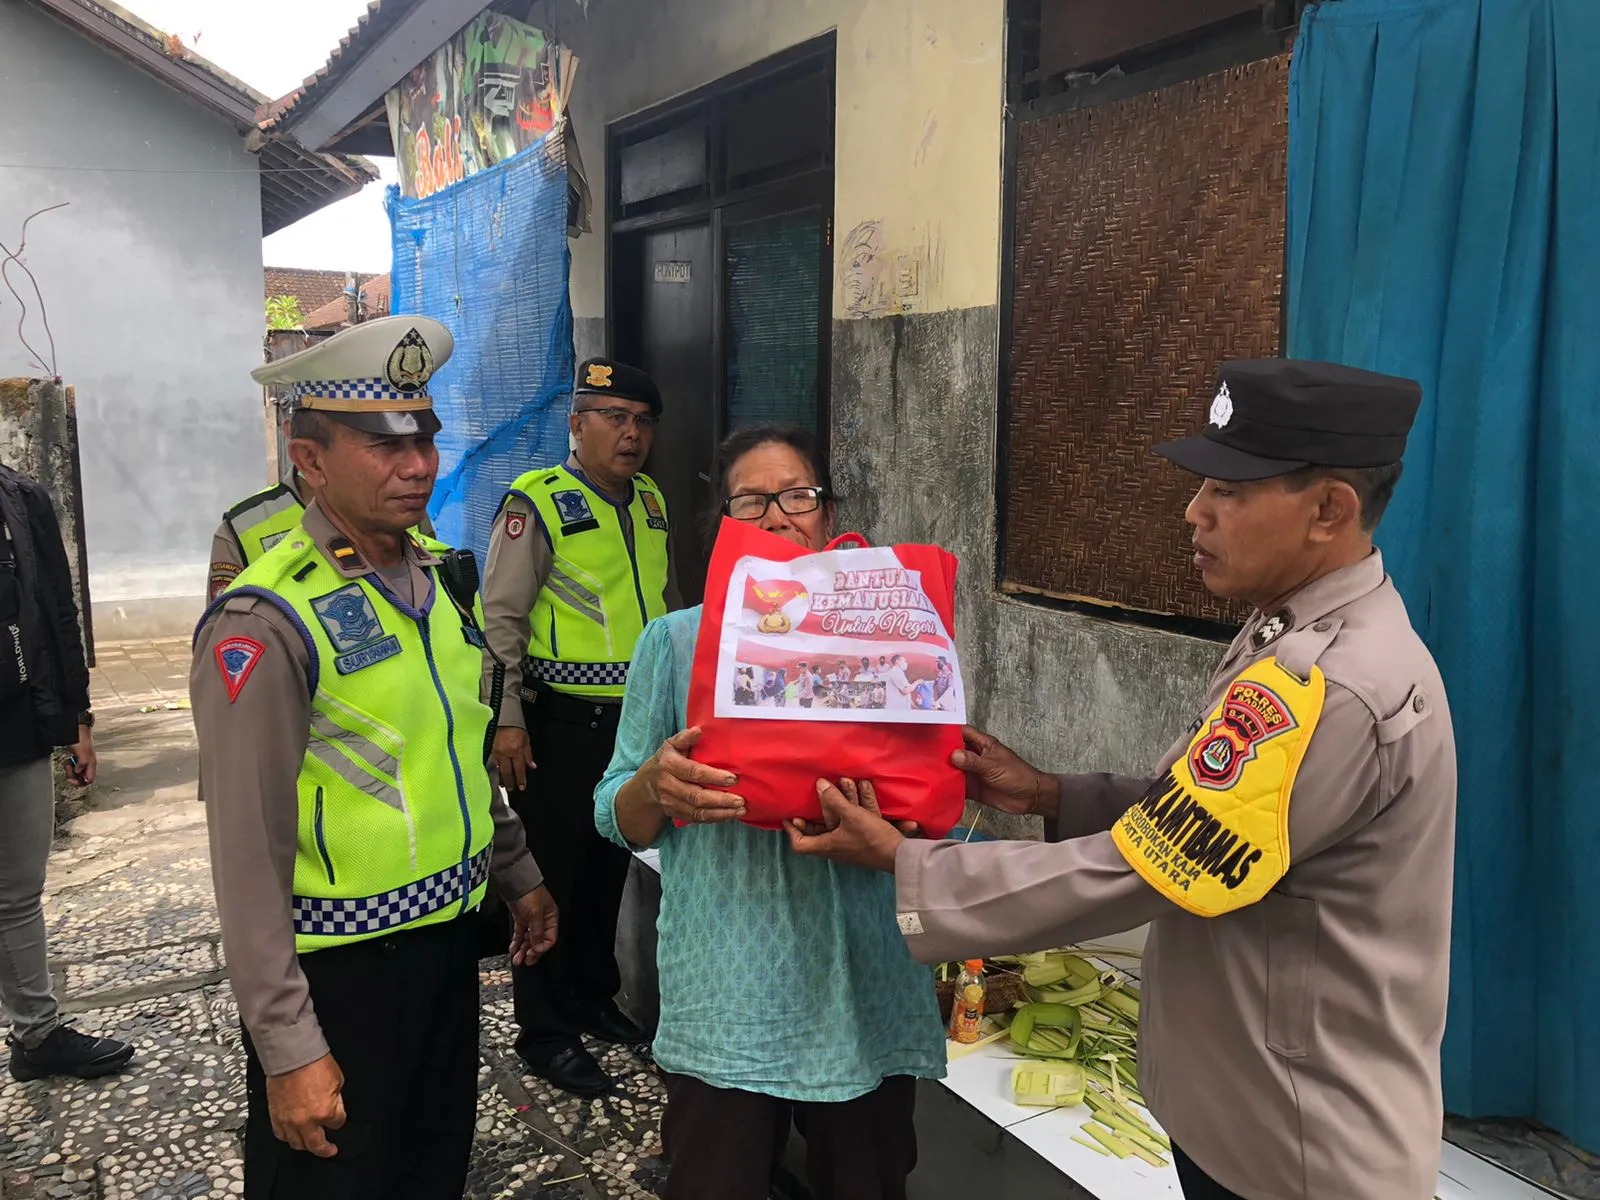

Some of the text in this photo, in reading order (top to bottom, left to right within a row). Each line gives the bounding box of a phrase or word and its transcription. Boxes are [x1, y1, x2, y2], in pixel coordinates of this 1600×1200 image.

[415, 114, 463, 200] Bali
[821, 610, 936, 640] Untuk Negeri
[1233, 686, 1283, 725] POLRES
[1237, 694, 1273, 724] BADUNG
[1228, 709, 1258, 736] BALI
[1143, 844, 1191, 892] UTARA
[1171, 852, 1202, 882] KAJA
